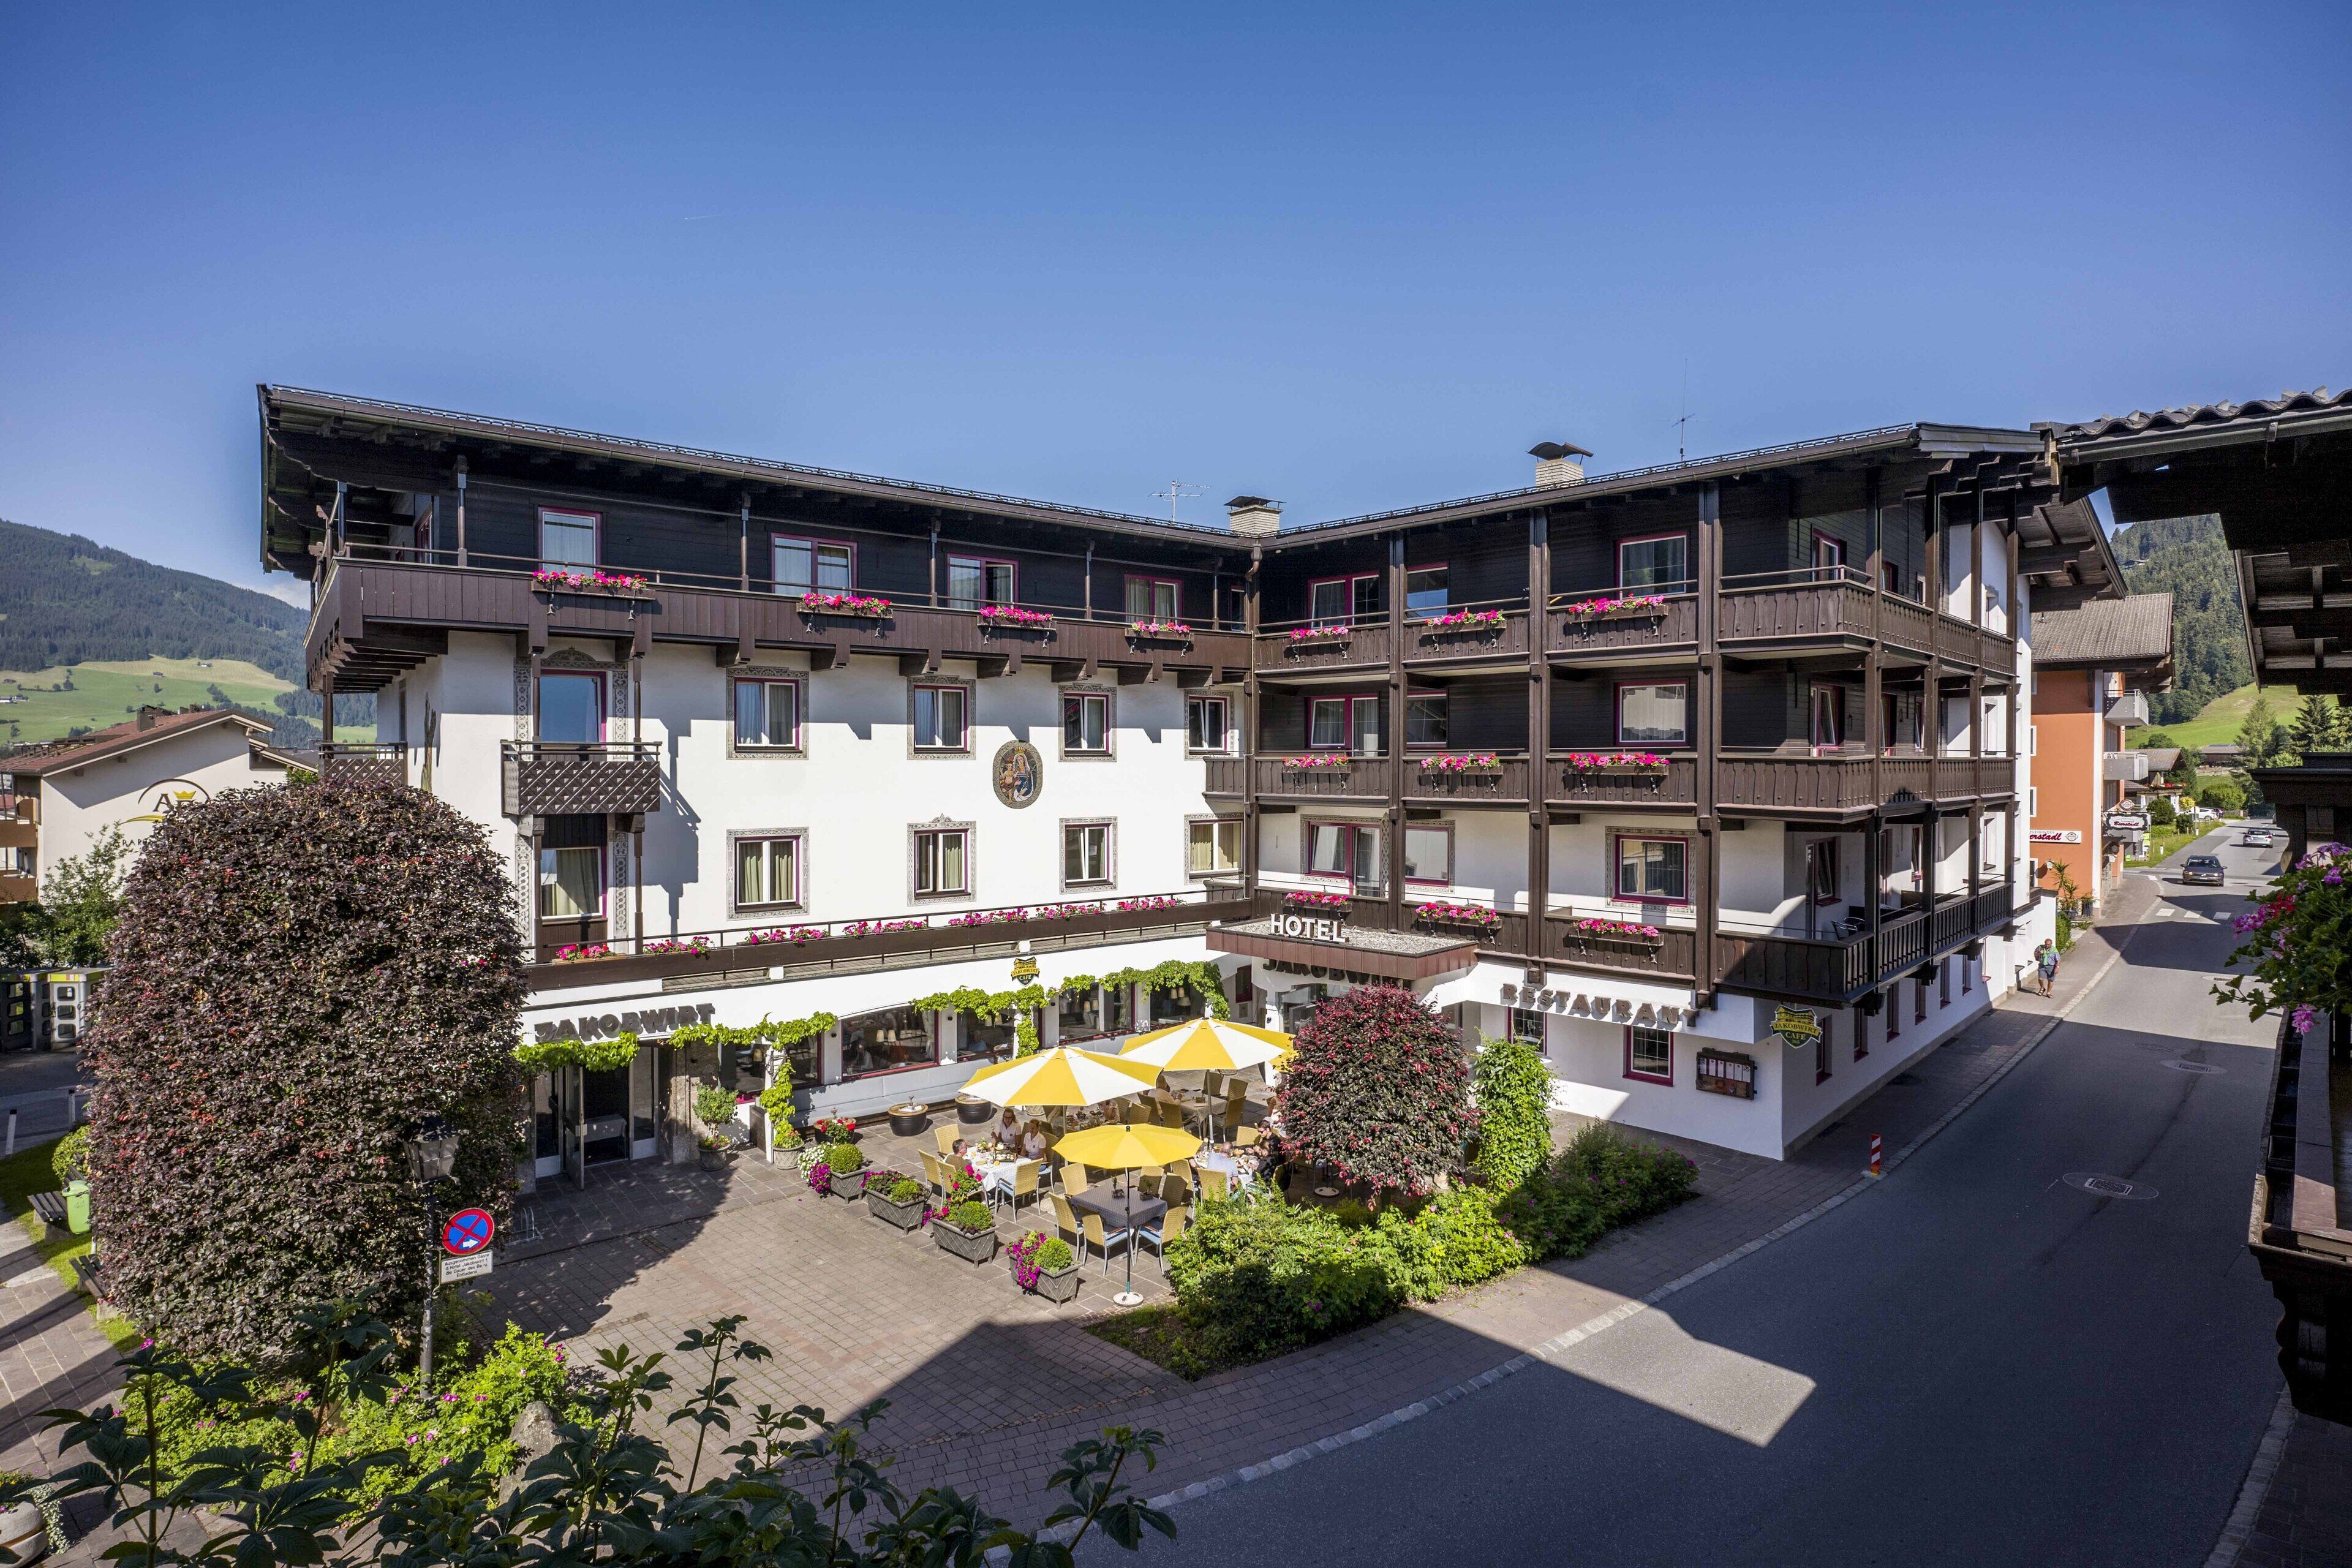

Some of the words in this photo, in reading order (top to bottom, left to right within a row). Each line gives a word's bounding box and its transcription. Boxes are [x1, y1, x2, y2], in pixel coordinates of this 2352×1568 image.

[1270, 914, 1346, 943] HOTEL
[1263, 958, 1411, 992] JAKOBW
[1502, 983, 1700, 1027] RESTAURANT
[534, 1003, 715, 1042] JAKOBWIRT
[1774, 1023, 1818, 1033] JAKOBWIRT
[445, 1256, 477, 1266] Ausgenommen
